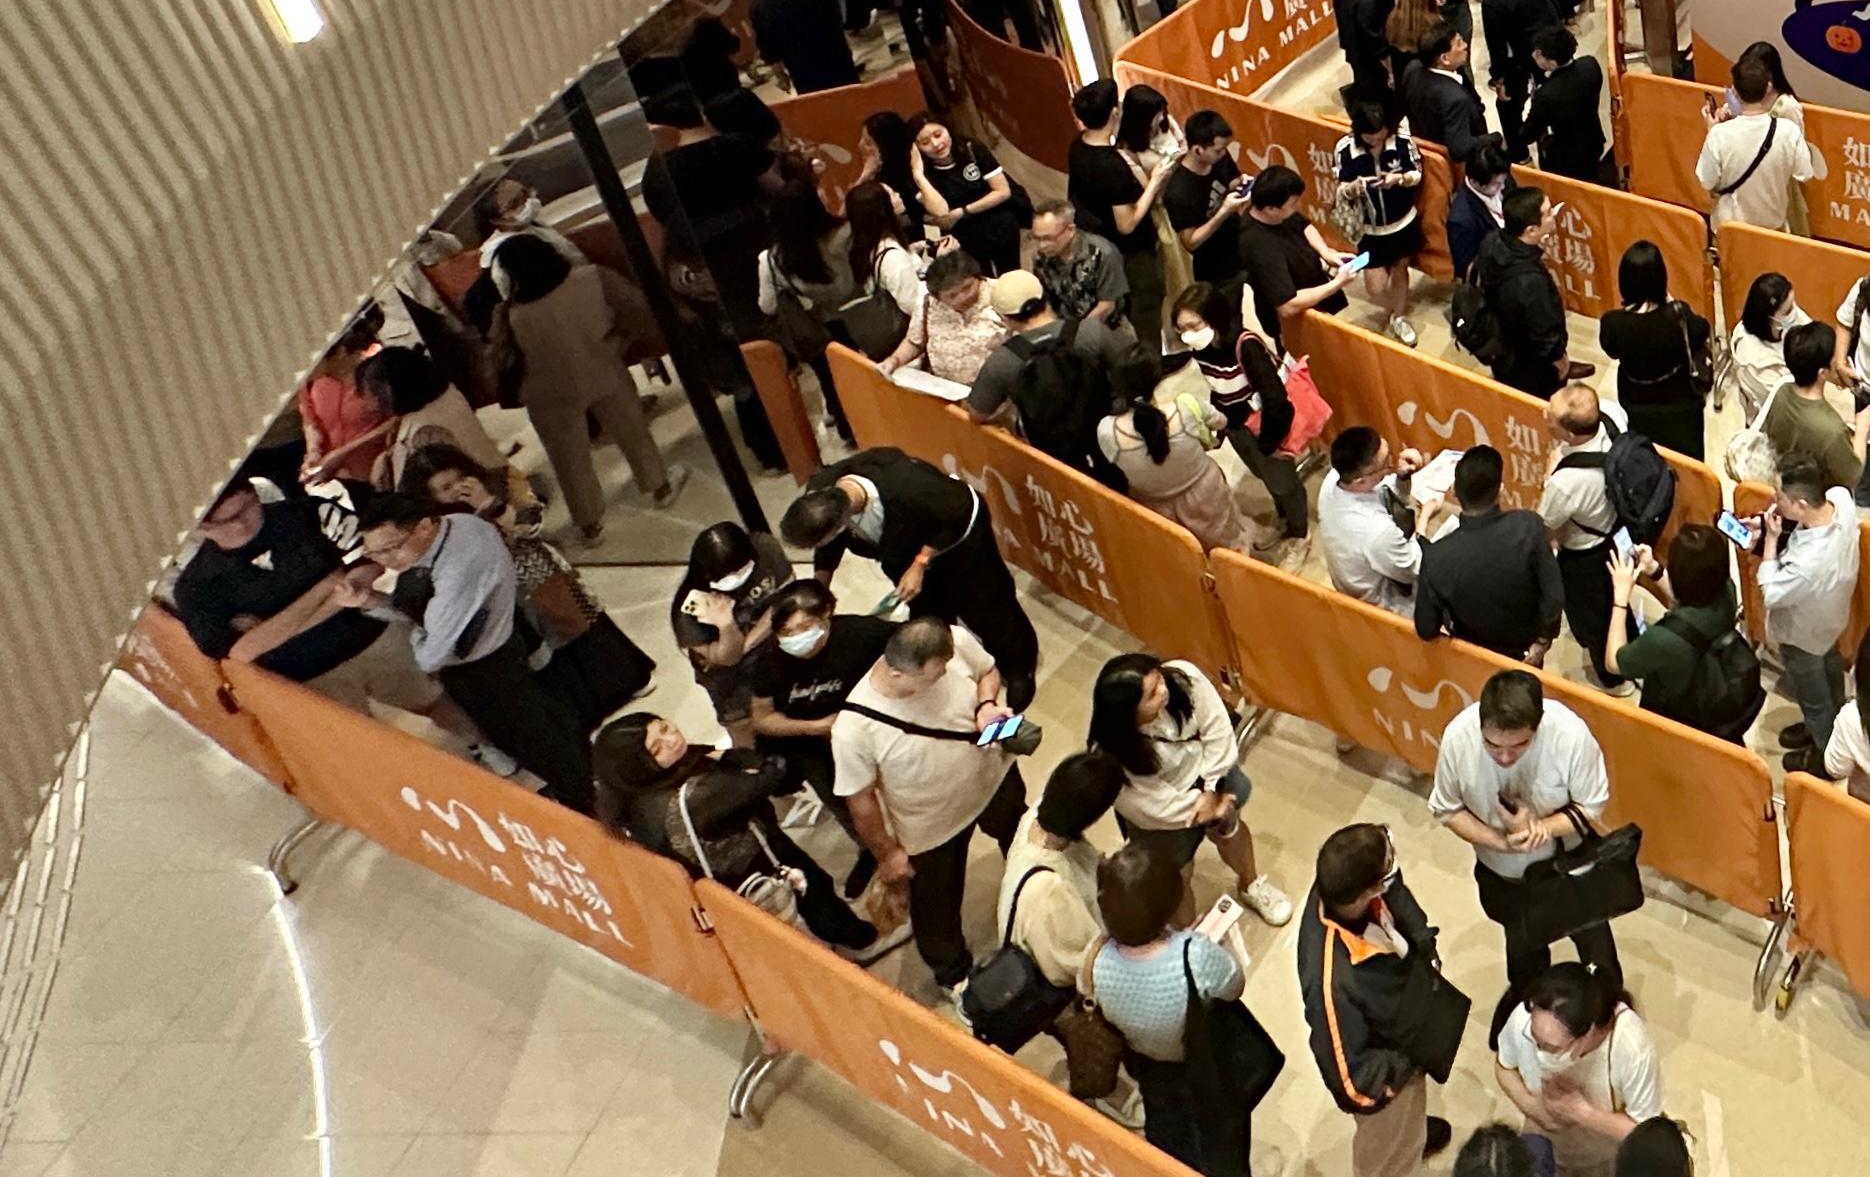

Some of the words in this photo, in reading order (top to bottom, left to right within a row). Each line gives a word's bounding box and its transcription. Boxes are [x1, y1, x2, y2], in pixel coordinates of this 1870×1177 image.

[1216, 46, 1271, 90] NINA
[1279, 0, 1334, 47] MALL
[1560, 207, 1592, 240] 心
[1505, 415, 1541, 456] 如
[1025, 473, 1094, 535] 如心
[1372, 706, 1440, 751] NIN
[498, 810, 586, 875] 如心
[421, 829, 513, 887] NINA
[528, 881, 634, 948] MALL
[523, 852, 612, 915] 廣場
